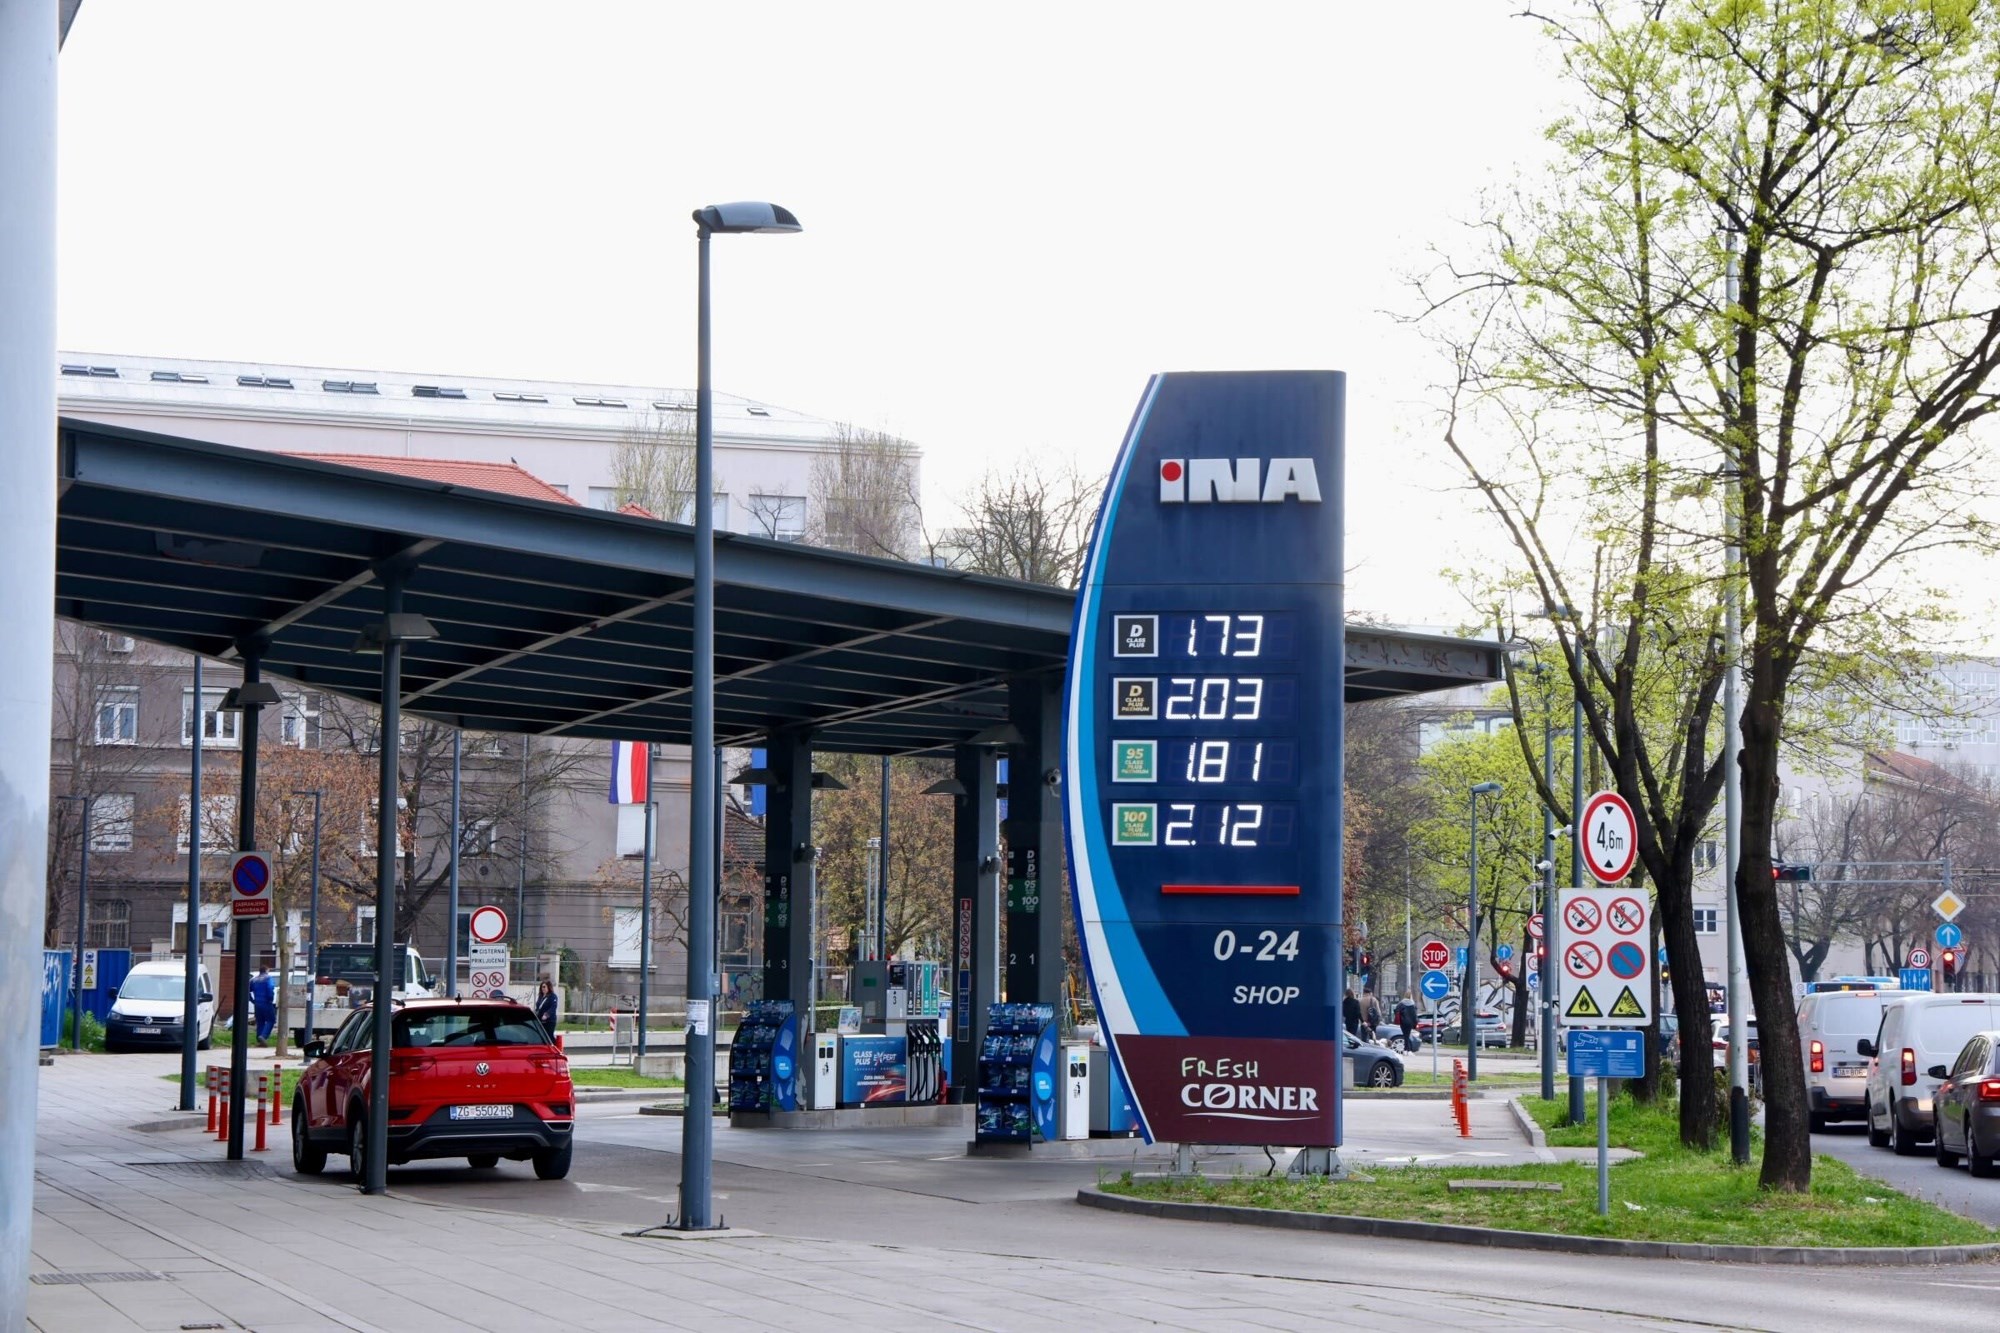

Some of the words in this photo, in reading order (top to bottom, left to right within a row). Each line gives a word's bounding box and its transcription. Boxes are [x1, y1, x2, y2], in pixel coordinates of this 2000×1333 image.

[1130, 624, 1144, 638] D
[1187, 615, 1264, 657] 1.73
[1129, 685, 1142, 697] D
[1166, 678, 1263, 720] 2.03
[1126, 748, 1144, 759] 95
[1186, 741, 1263, 782] 1.81
[1124, 812, 1147, 822] 100
[1165, 804, 1263, 846] 2.12
[1022, 896, 1039, 905] 100
[1010, 954, 1016, 964] 2
[1029, 954, 1034, 964] 1
[1424, 950, 1447, 961] STOP
[1912, 954, 1925, 964] 40
[766, 960, 771, 968] 4
[781, 960, 787, 968] 3
[1233, 985, 1300, 1004] SHOP
[893, 996, 896, 1005] 3
[1181, 1057, 1258, 1078] FRESH
[1181, 1083, 1319, 1111] CORNER
[458, 1106, 470, 1117] ZG
